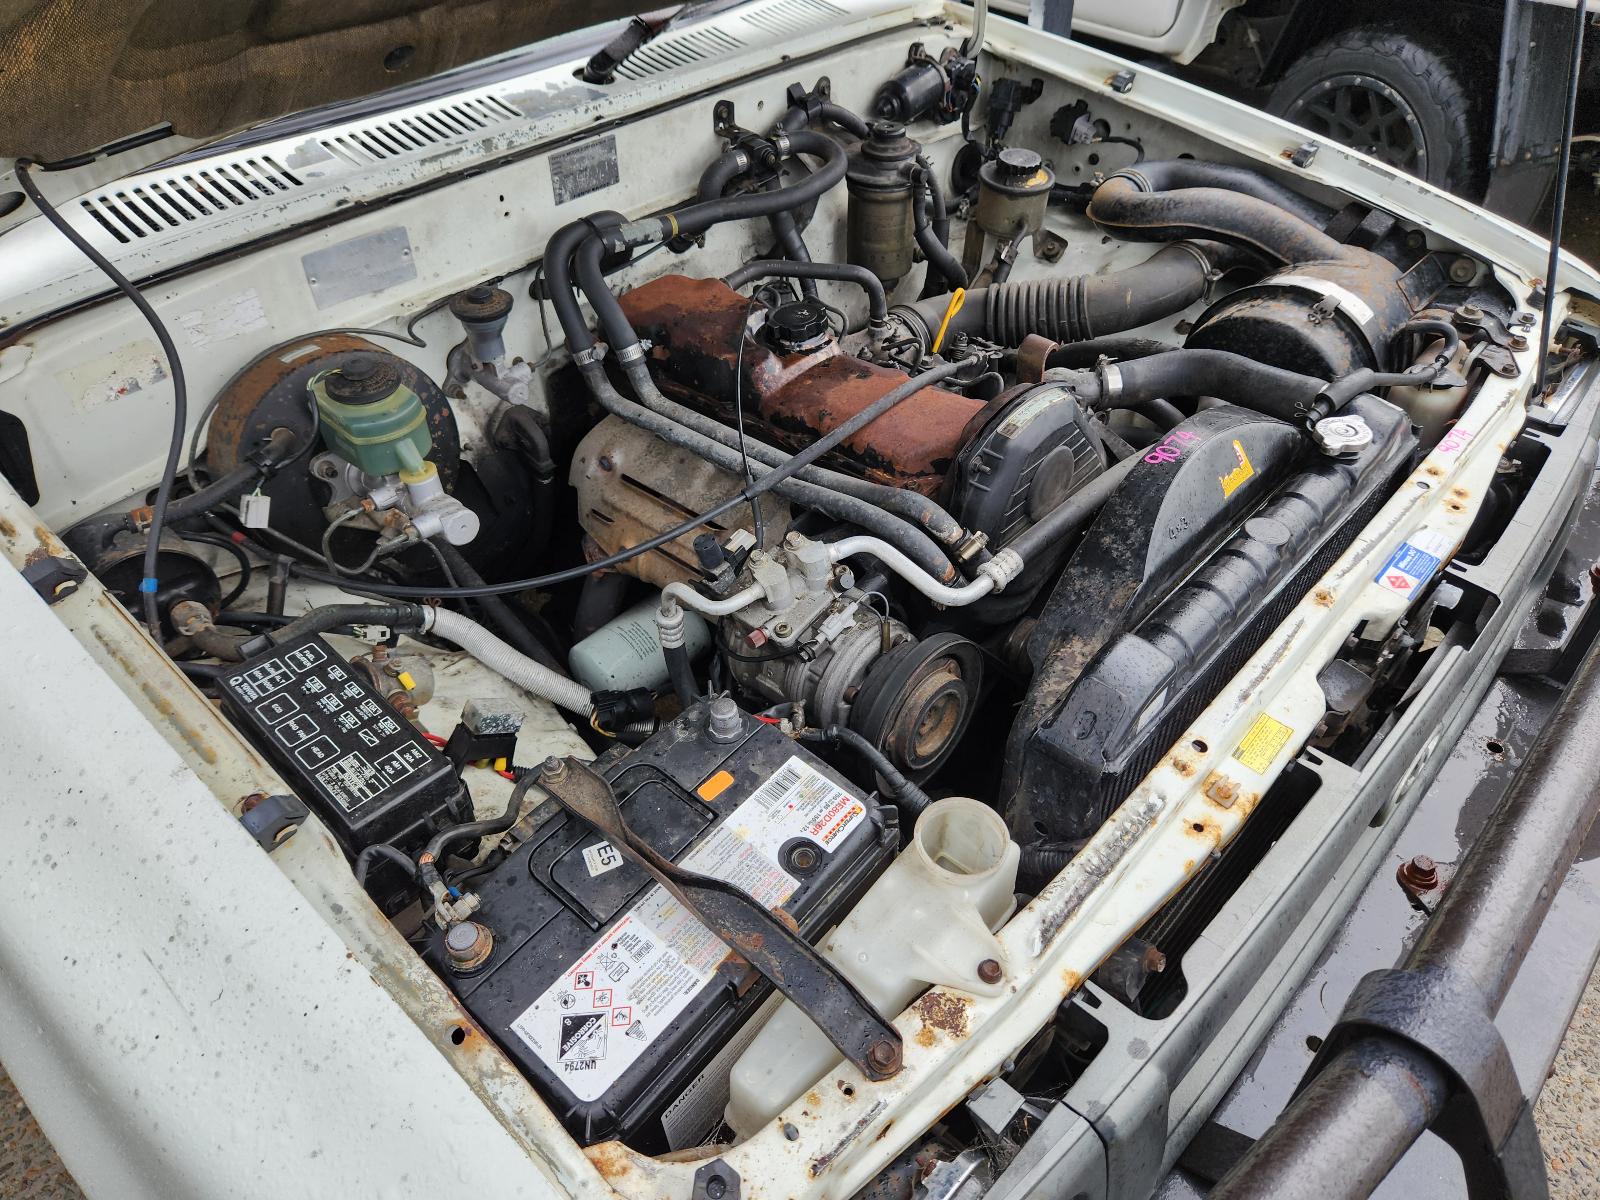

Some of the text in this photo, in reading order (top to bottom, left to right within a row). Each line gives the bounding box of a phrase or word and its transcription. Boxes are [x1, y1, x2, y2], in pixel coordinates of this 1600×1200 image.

[1144, 431, 1201, 464] 9074
[1438, 429, 1473, 452] 9074
[294, 651, 312, 667] HEATER
[303, 649, 316, 661] FUEL
[274, 674, 286, 684] ALT
[240, 682, 259, 700] TOYOTA
[287, 720, 307, 739] RAD FAN
[311, 745, 325, 759] HEAD
[403, 753, 415, 763] 30A
[410, 748, 422, 759] AM2
[383, 764, 396, 775] 40A
[391, 760, 403, 770] AM1
[594, 842, 618, 867] E5
[564, 1018, 572, 1026] 8
[562, 1017, 597, 1052] CORROSIVE
[564, 1060, 597, 1072] UN2794
[664, 1073, 706, 1120] DANGER
